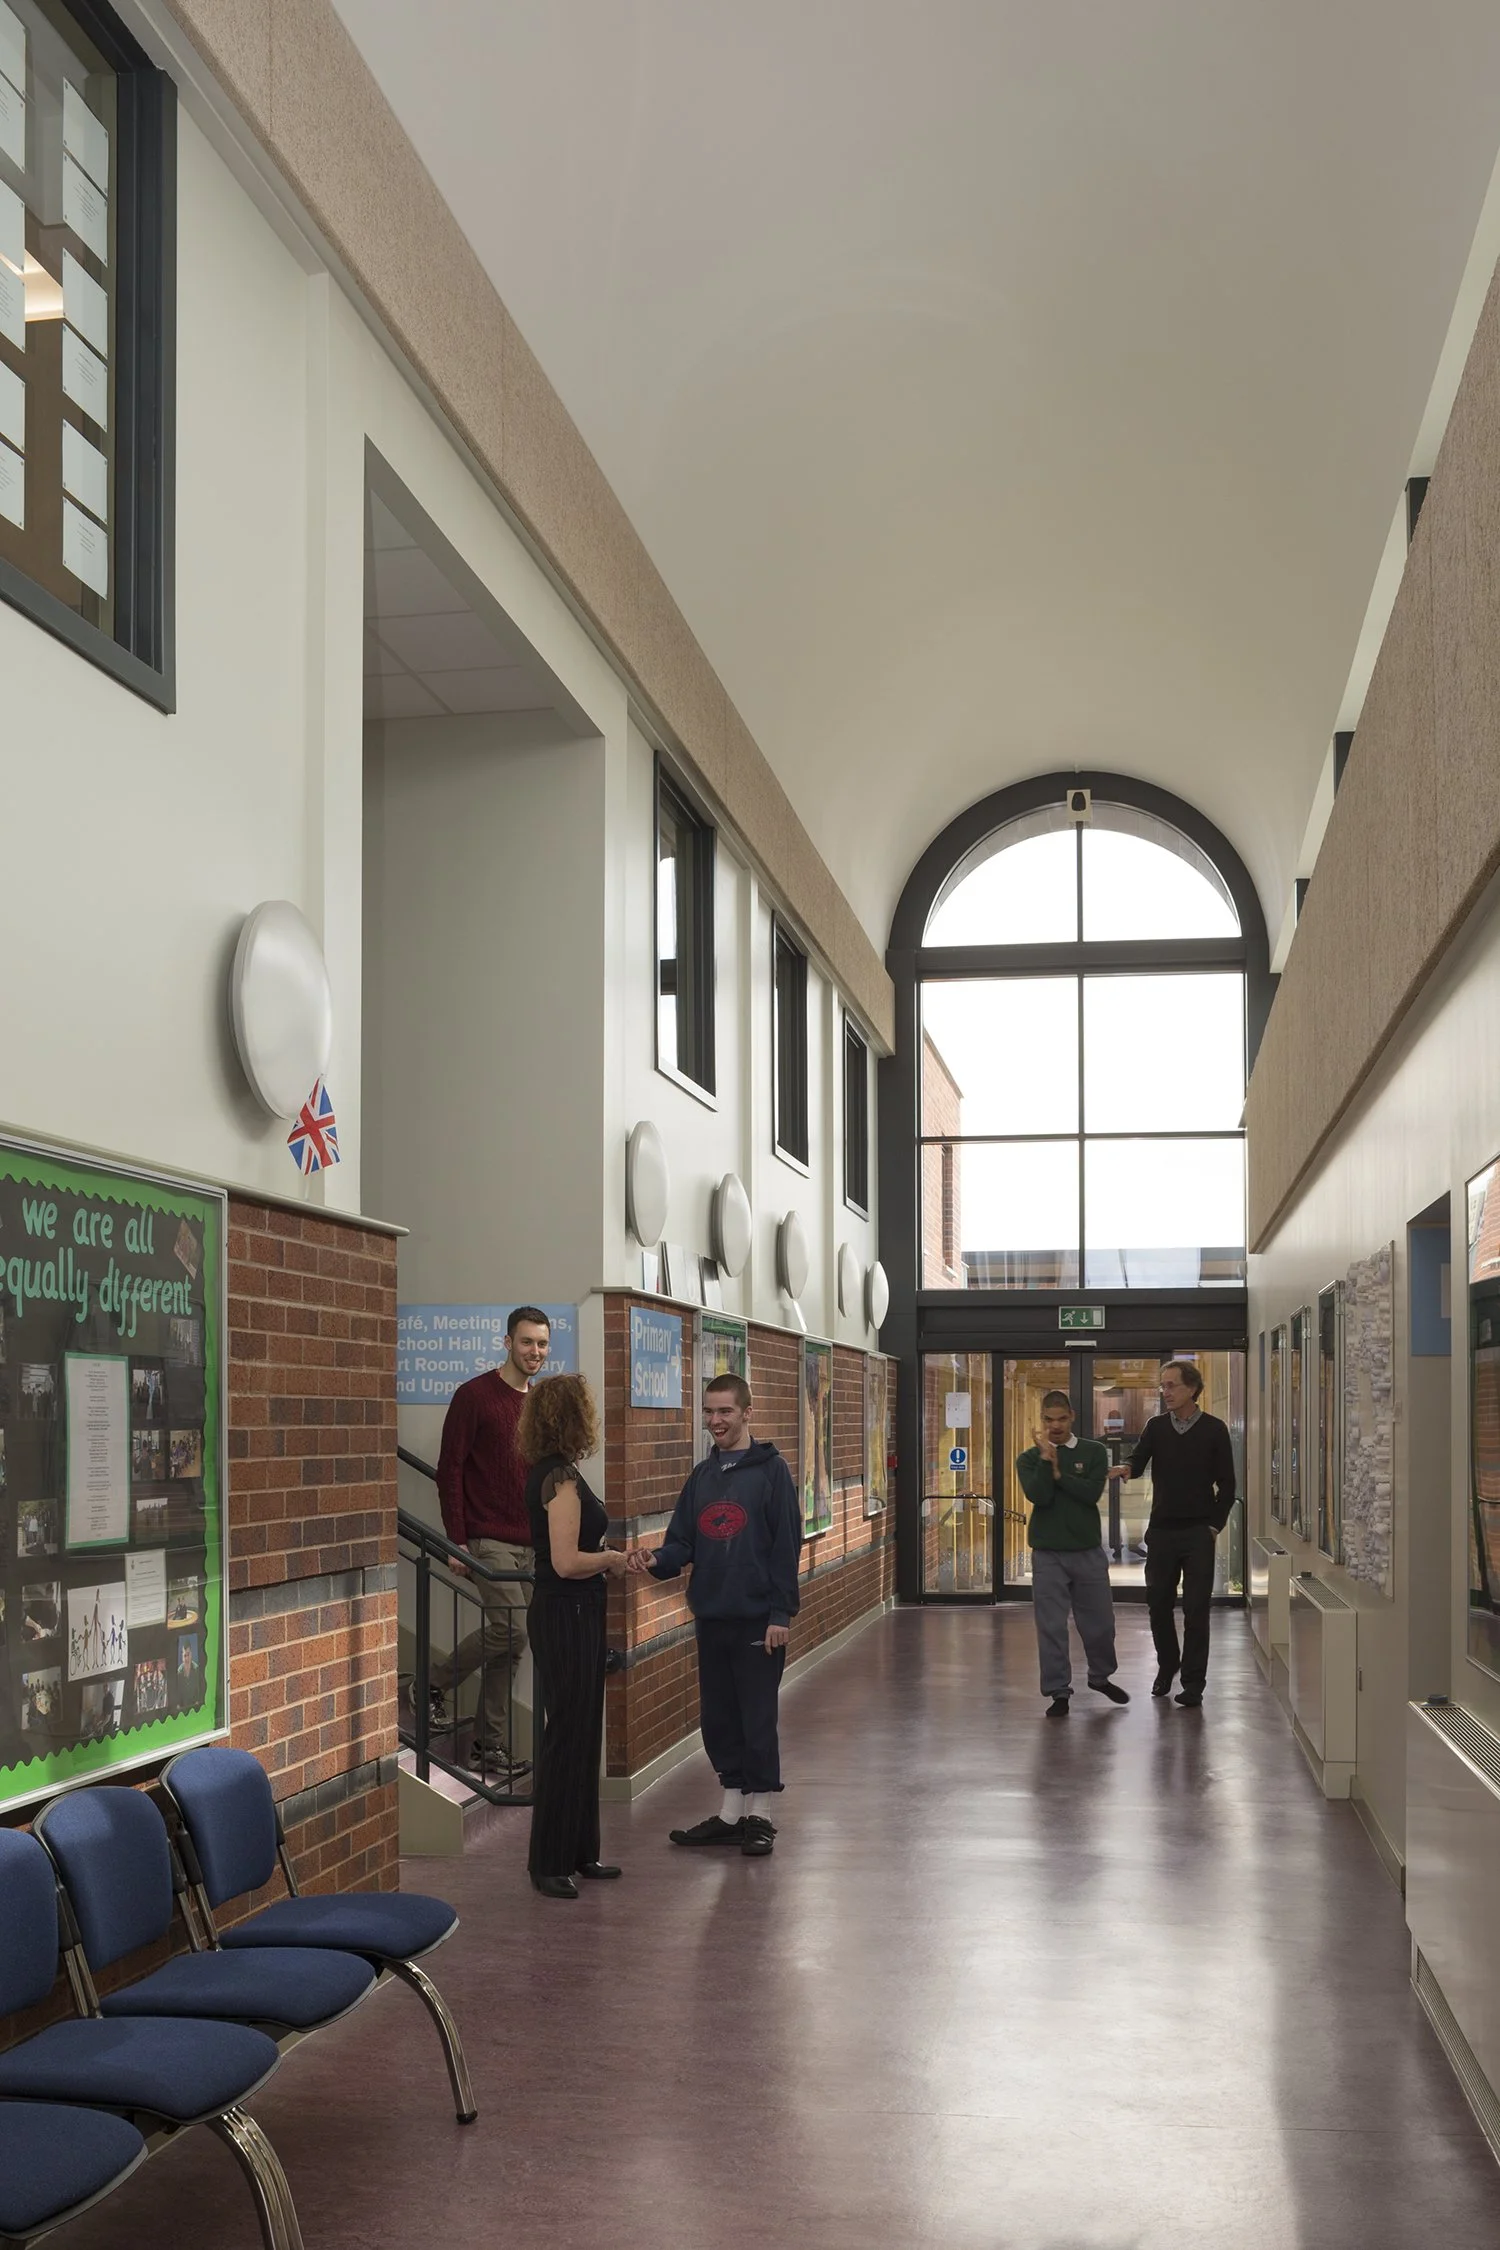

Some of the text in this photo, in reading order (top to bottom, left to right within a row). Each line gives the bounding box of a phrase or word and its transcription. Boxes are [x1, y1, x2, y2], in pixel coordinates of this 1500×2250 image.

[22, 1197, 154, 1254] we are all
[99, 1257, 192, 1338] different
[397, 1315, 428, 1333] afé,
[433, 1315, 501, 1333] Meeting
[397, 1336, 443, 1351] chool
[449, 1336, 486, 1353] Hall,
[634, 1316, 672, 1361] Primary
[397, 1356, 566, 1374] rt Room, Secary
[396, 1378, 464, 1396] nd Uppe
[634, 1362, 669, 1398] School
